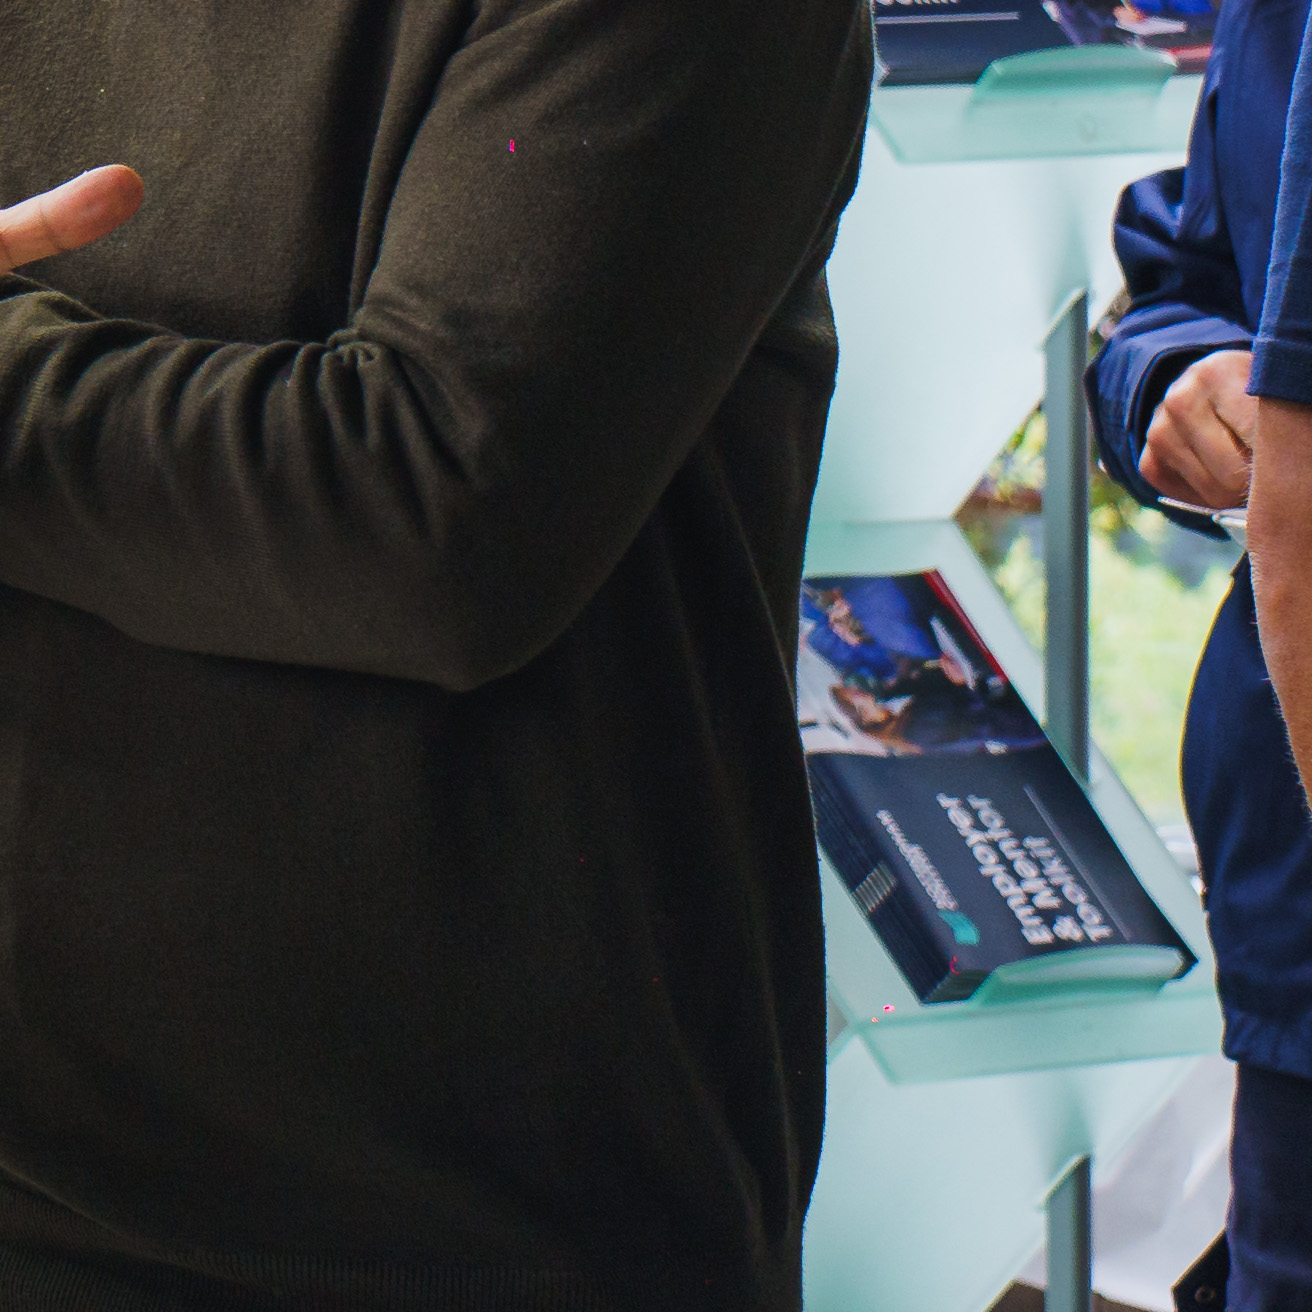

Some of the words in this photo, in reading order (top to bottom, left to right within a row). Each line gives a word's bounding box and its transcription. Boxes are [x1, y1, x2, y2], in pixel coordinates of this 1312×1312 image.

[936, 792, 1055, 945] Employer
[967, 794, 1062, 909] Mentor
[1023, 835, 1113, 942] Toolkit
[1052, 915, 1085, 942] &
